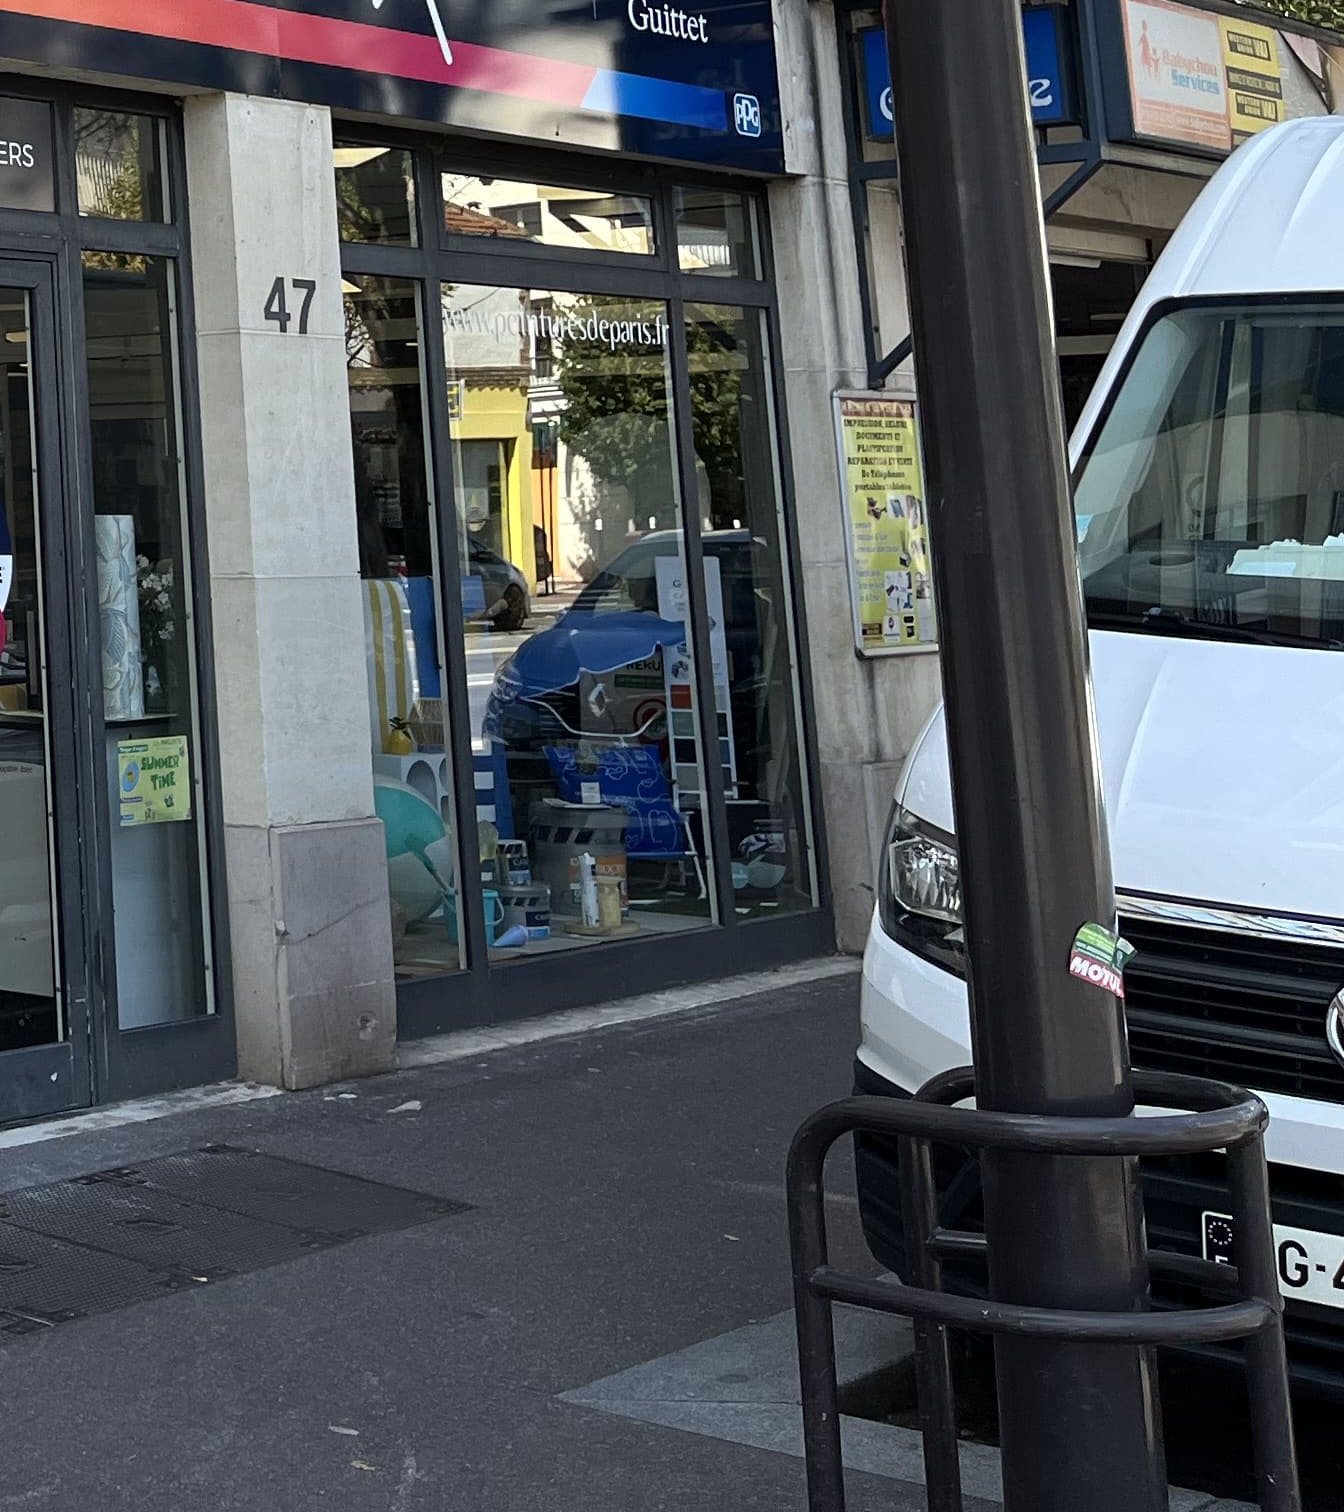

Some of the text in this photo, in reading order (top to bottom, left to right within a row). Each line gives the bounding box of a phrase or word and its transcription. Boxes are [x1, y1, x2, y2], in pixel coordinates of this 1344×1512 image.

[735, 98, 759, 131] PPG
[263, 276, 316, 335] 47
[1070, 956, 1125, 999] MOTUL
